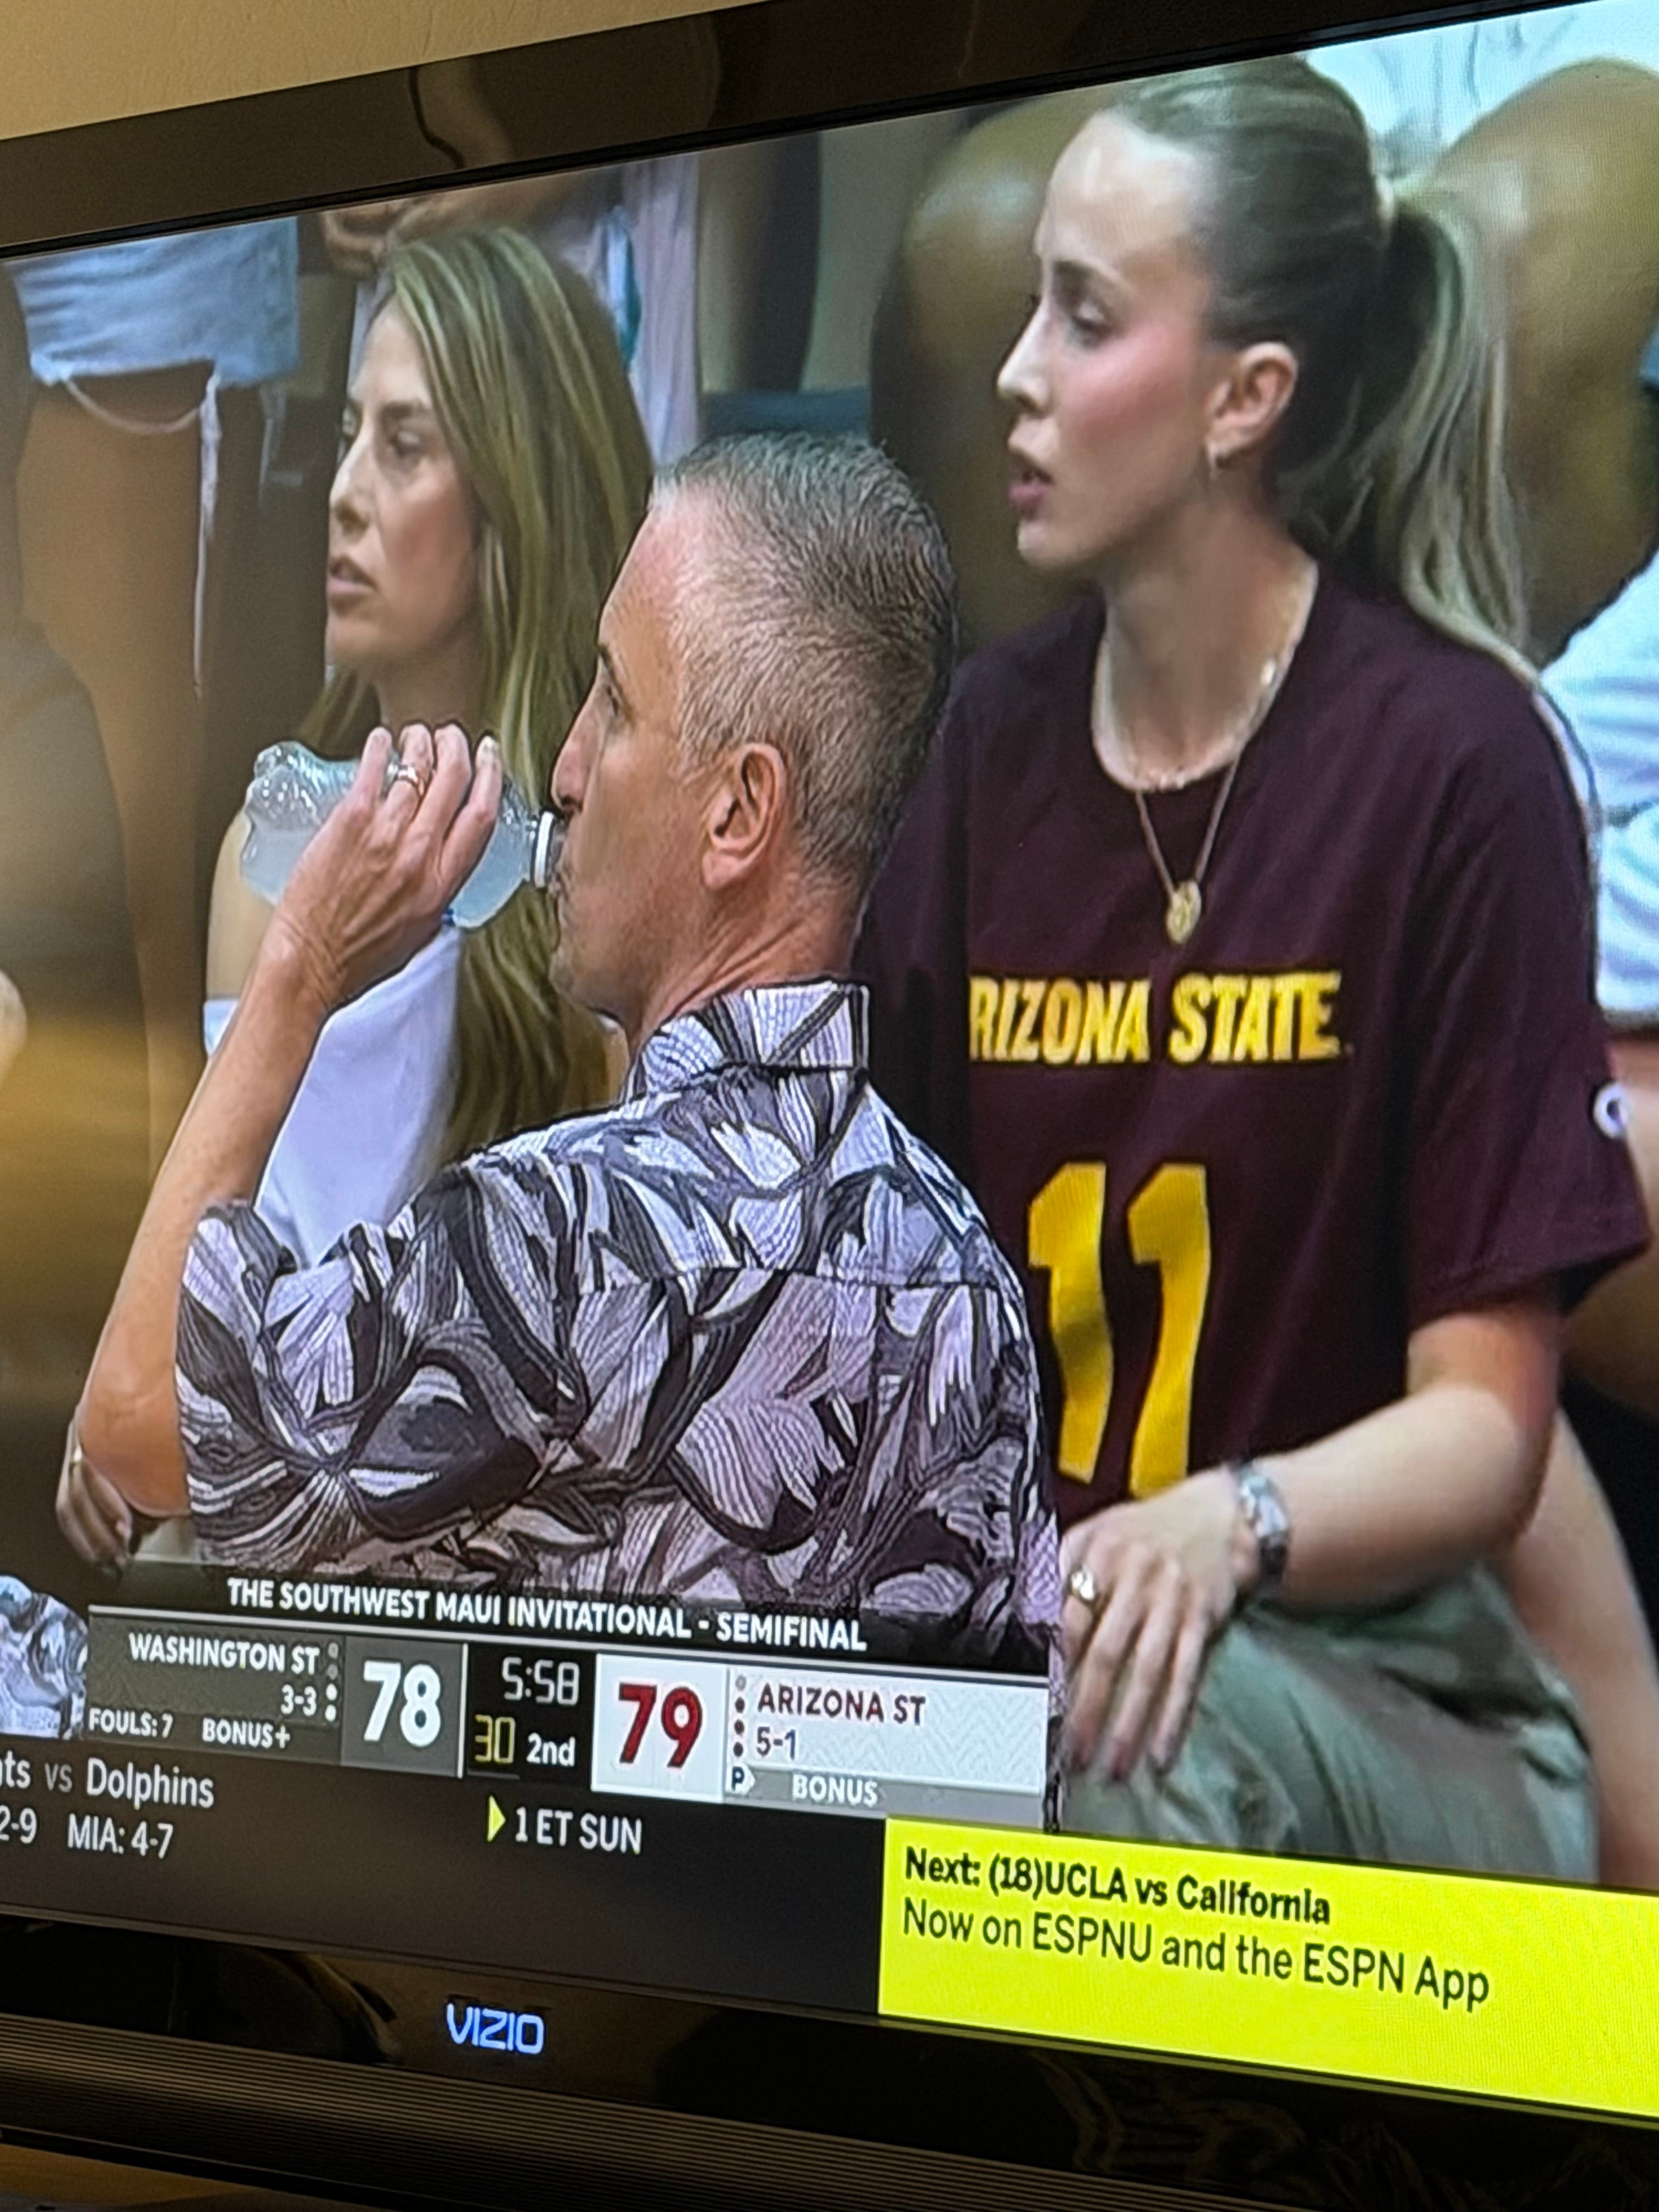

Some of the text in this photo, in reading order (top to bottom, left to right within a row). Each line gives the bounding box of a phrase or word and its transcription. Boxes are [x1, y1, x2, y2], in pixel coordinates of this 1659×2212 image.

[1170, 971, 1341, 1064] STATE
[1028, 1161, 1210, 1499] 11
[228, 1578, 274, 1609] THE
[279, 1582, 430, 1620] SOUTHWEST
[436, 1591, 500, 1624] MAUI
[508, 1597, 692, 1639] INVITATIONAL
[716, 1612, 867, 1651] SEMIFINAL
[129, 1632, 320, 1675] WASHINGTON ST
[281, 1684, 317, 1717] 3-3
[363, 1660, 441, 1748] 78
[502, 1656, 580, 1706] 5:58
[757, 1683, 926, 1726] ARIZONA ST
[88, 1707, 173, 1738] FOULS: 7
[202, 1718, 290, 1750] BONUS+
[475, 1714, 516, 1764] 30
[618, 1682, 703, 1768] 79
[757, 1727, 797, 1761] 5-1
[527, 1733, 576, 1768] 2nd
[0, 1750, 215, 1810] ts vs Dolphins
[793, 1774, 878, 1807] BONUS
[68, 1813, 125, 1854] MIA:
[131, 1820, 174, 1859] 4-7
[516, 1807, 642, 1855] 1 ET SUN
[906, 1846, 1330, 1925] Next: (18)UCLA vs California
[904, 1897, 1489, 2013] Now on ESPNU and the ESPN App
[447, 2002, 544, 2055] VIZIO
